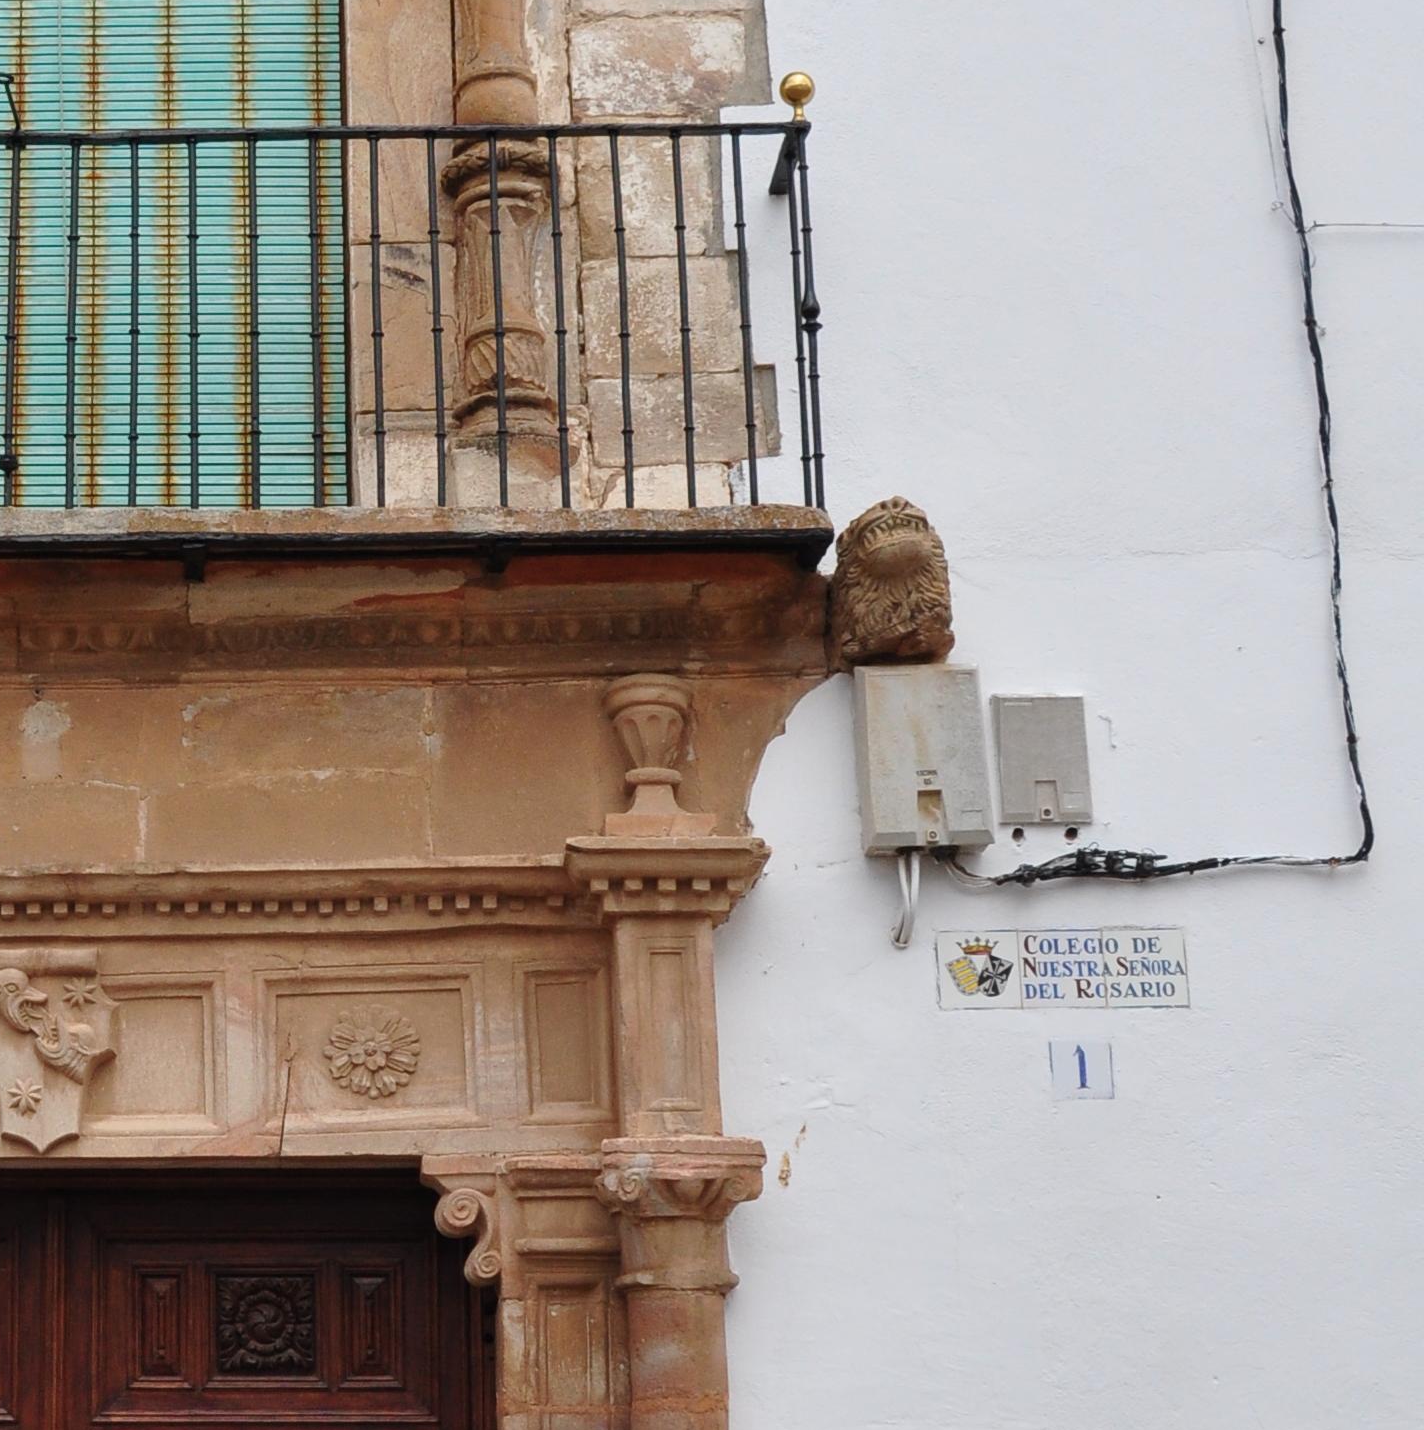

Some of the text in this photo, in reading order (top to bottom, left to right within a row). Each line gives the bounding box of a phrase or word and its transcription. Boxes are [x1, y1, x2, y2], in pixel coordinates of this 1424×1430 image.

[1024, 935, 1162, 955] COLEGIO DE
[1022, 956, 1186, 978] NUESTRA SEÑORA
[1024, 978, 1176, 1000] DEL ROSARIO
[1071, 1044, 1092, 1090] 1
